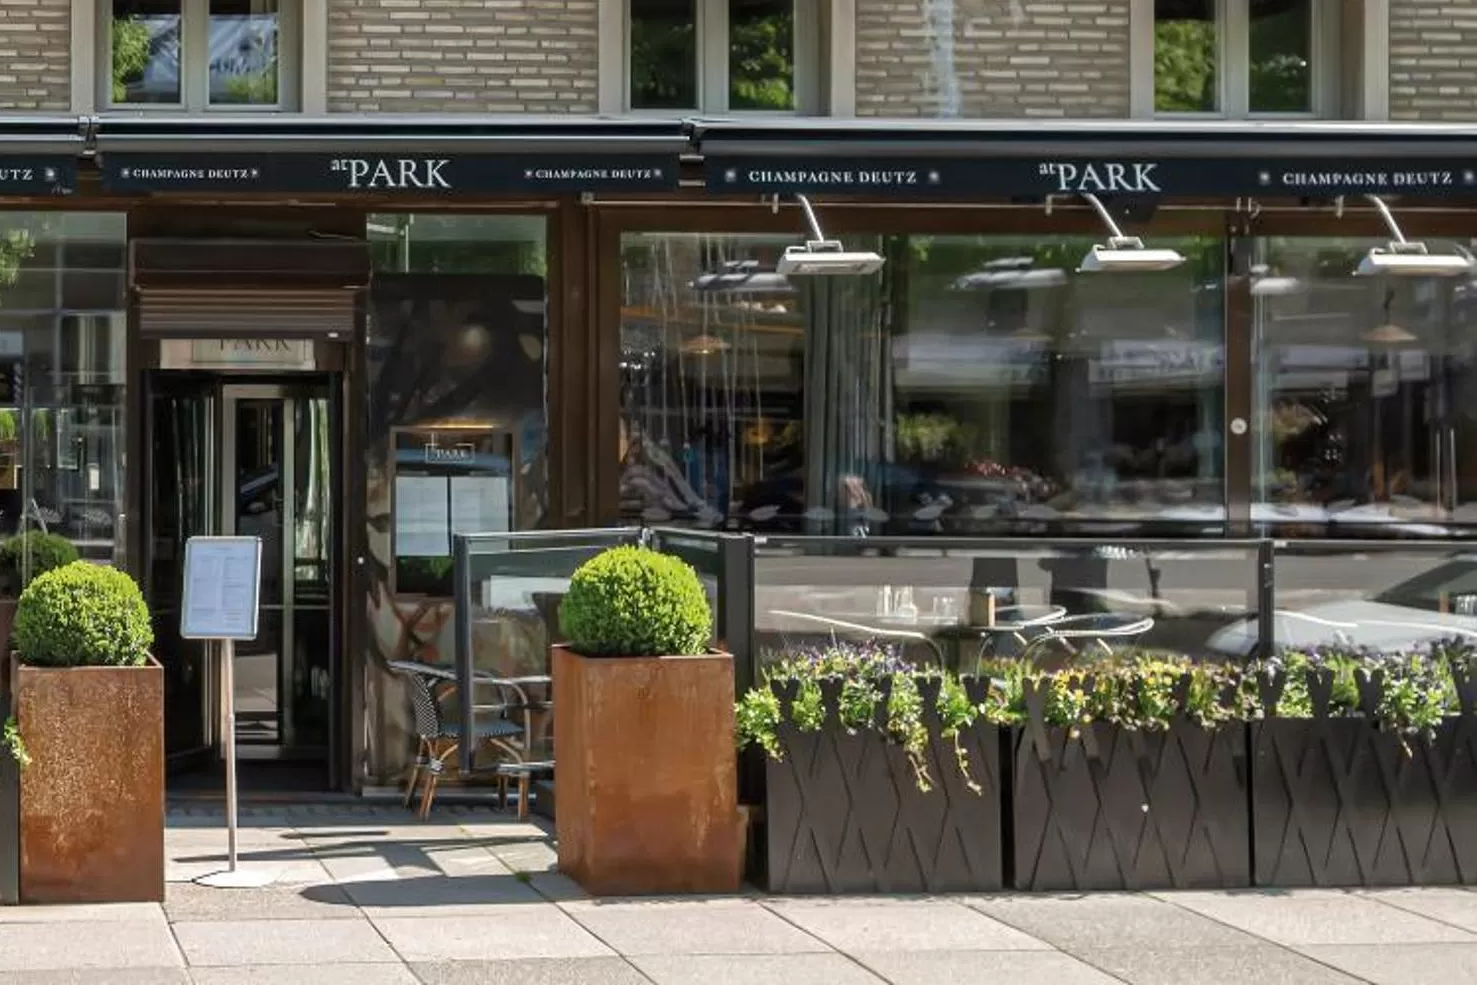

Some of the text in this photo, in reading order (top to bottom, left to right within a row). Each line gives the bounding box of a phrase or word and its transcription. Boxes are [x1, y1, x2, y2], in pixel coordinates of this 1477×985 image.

[133, 168, 248, 179] CHAMPAGNE DEUTZ
[535, 168, 651, 179] CHAMPAGNE DEUTZ
[748, 170, 917, 184] CHAMPAGNE DEUTZ
[1282, 171, 1453, 185] CHAMPAGNE DEUTZ
